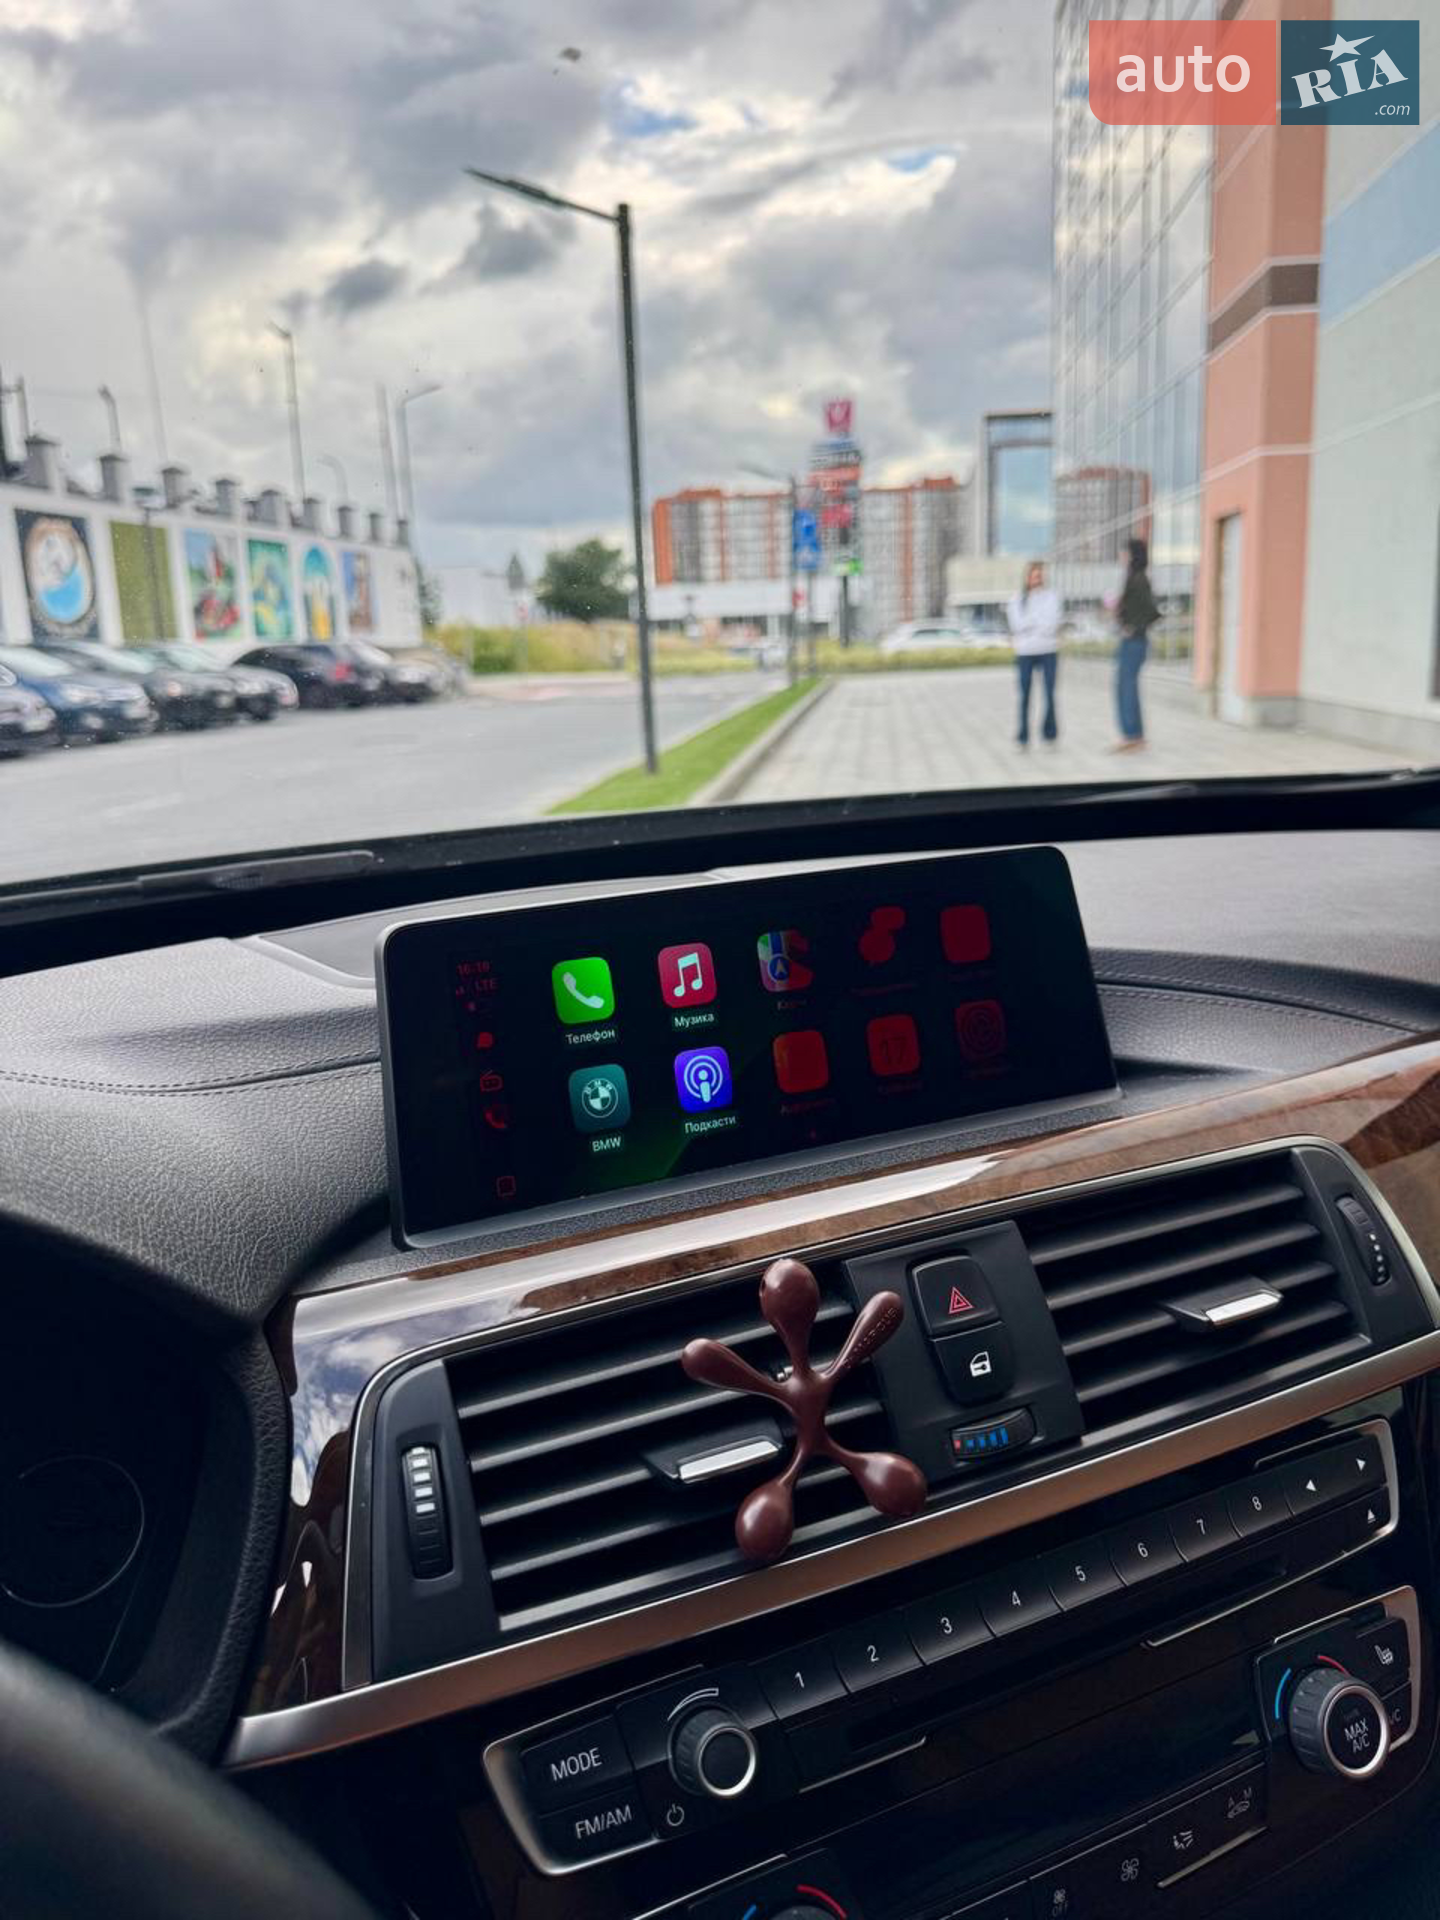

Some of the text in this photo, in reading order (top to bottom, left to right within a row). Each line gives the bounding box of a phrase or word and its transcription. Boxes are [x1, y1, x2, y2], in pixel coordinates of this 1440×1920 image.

[673, 1012, 715, 1028] Музика
[565, 1027, 616, 1046] Телефон
[684, 1114, 737, 1134] Подкасти
[592, 1136, 622, 1153] BMW
[1251, 1495, 1263, 1512] 8
[1195, 1518, 1207, 1536] 7
[1136, 1542, 1149, 1559] 6
[1074, 1564, 1087, 1583] 5
[1010, 1590, 1022, 1608] 4
[940, 1616, 954, 1635] 3
[866, 1644, 880, 1663] 2
[794, 1671, 806, 1688] 1
[1343, 1717, 1370, 1742] MAX
[1352, 1733, 1371, 1754] A/C
[550, 1746, 603, 1782] MODE
[574, 1804, 634, 1840] FM/AM
